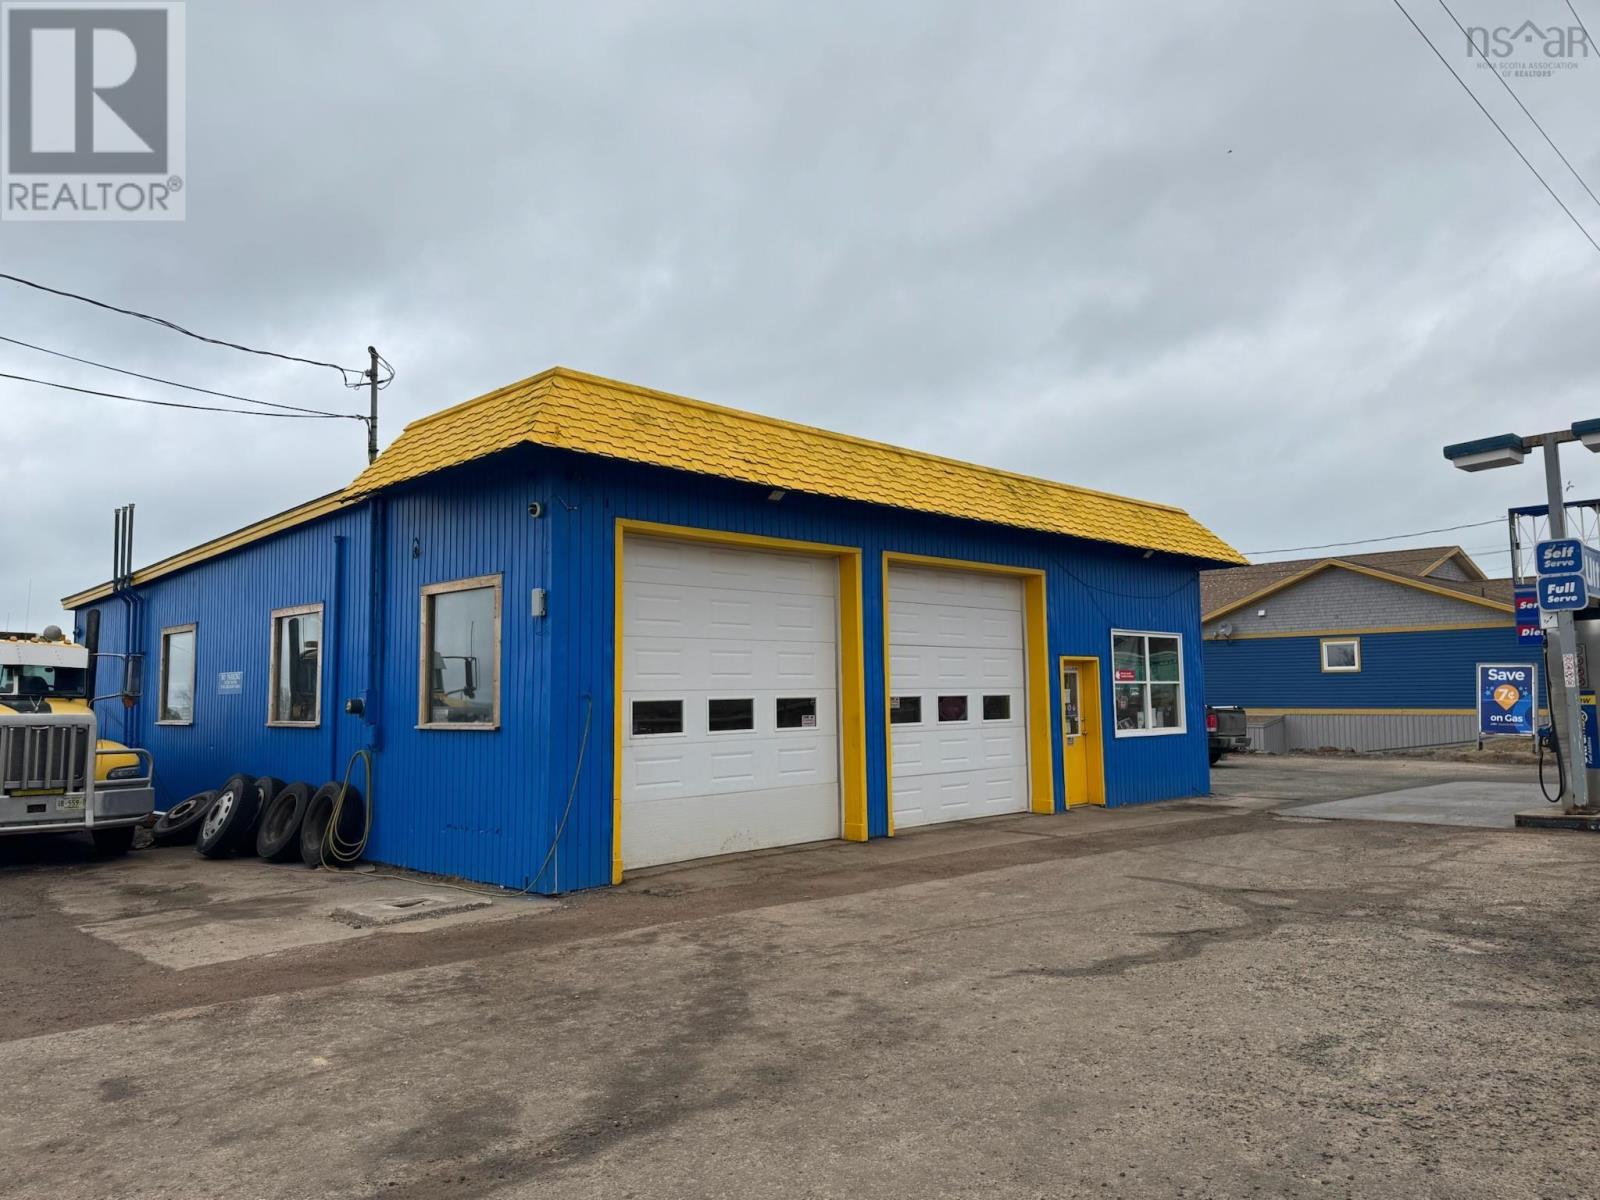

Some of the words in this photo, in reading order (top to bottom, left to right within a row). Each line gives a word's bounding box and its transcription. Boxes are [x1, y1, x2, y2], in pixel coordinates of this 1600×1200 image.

[1543, 546, 1573, 560] Self
[1544, 560, 1575, 568] Serve
[1547, 582, 1575, 594] Full
[1547, 595, 1578, 603] Serve
[1488, 668, 1526, 681] Save
[1498, 689, 1515, 701] 7¢
[1490, 714, 1503, 722] on
[1505, 714, 1524, 723] Gas
